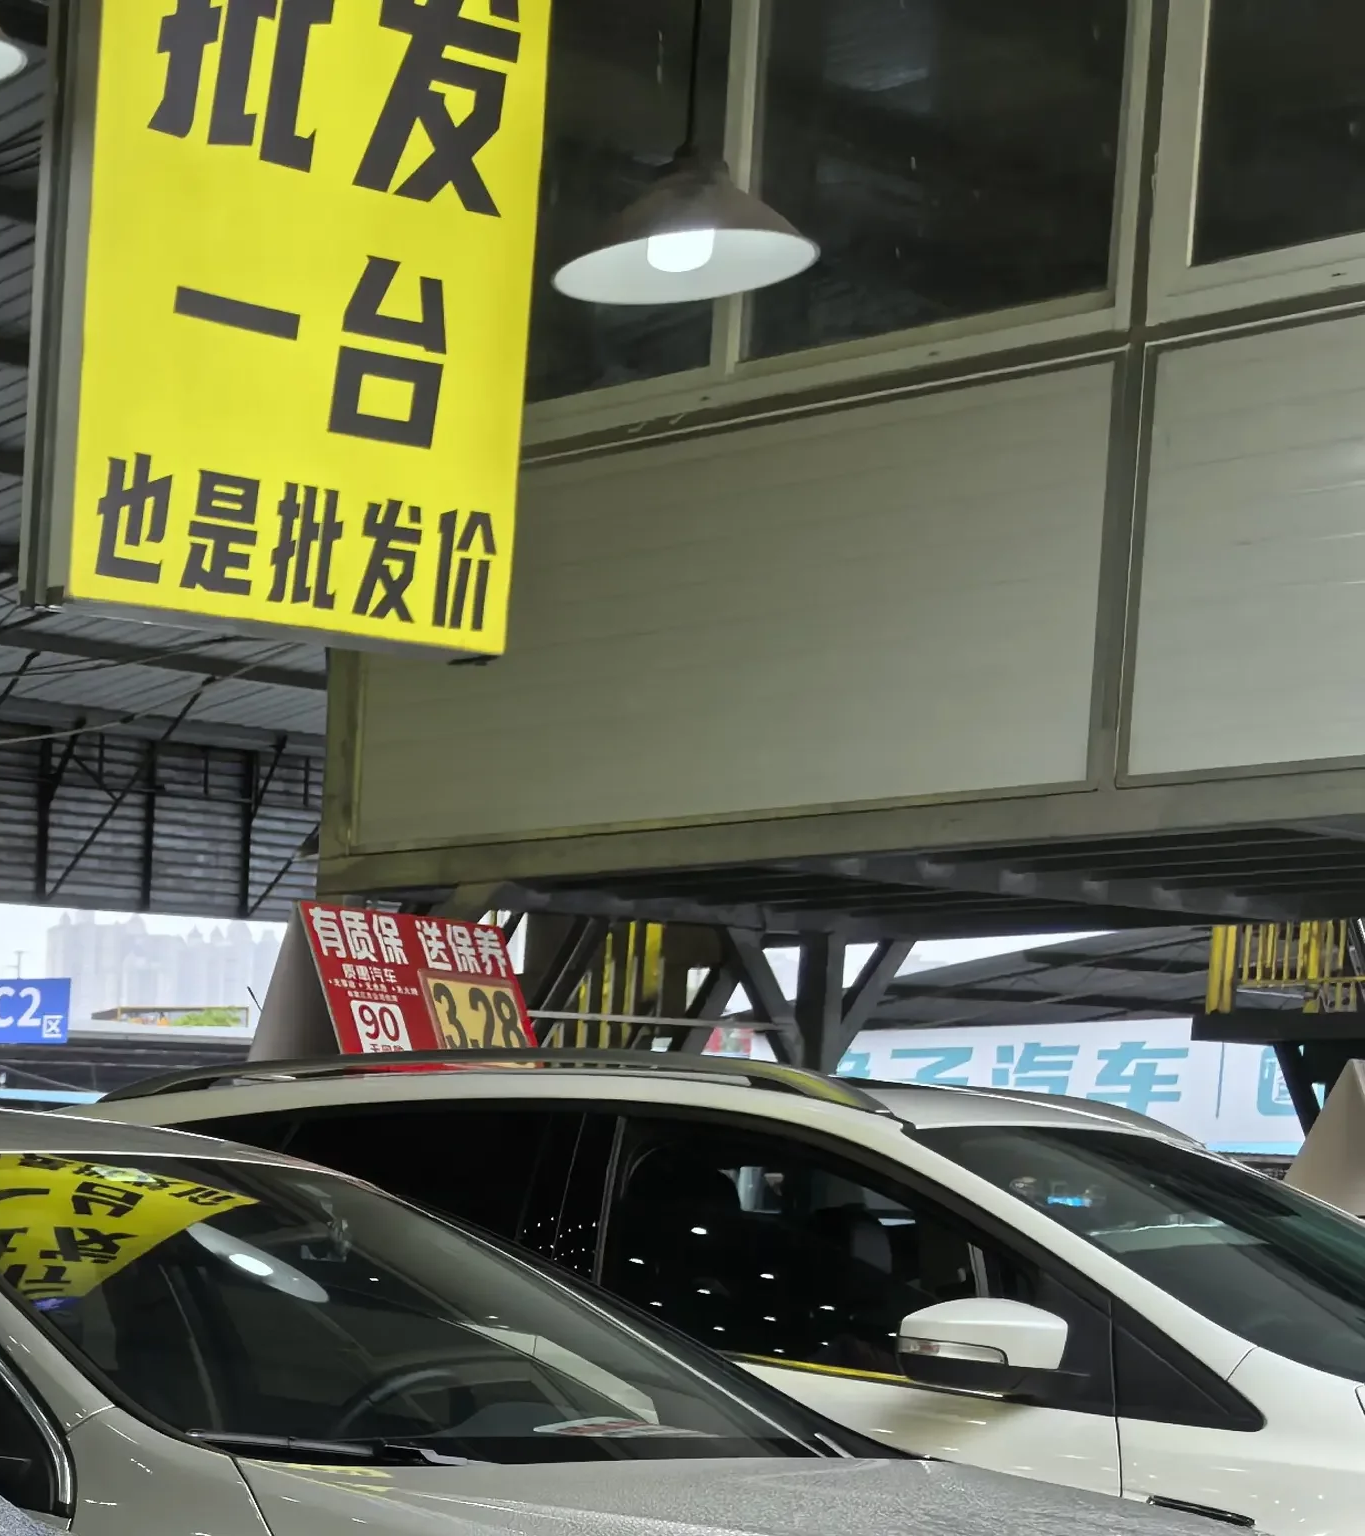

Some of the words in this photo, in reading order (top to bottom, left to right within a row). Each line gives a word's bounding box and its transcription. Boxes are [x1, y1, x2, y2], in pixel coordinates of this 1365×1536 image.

[174, 255, 447, 450] 一台
[95, 453, 497, 632] 也是批发价
[309, 907, 409, 965] 有质保
[415, 920, 507, 978] 送保养
[359, 1005, 400, 1041] 90
[433, 983, 526, 1050] 3.28
